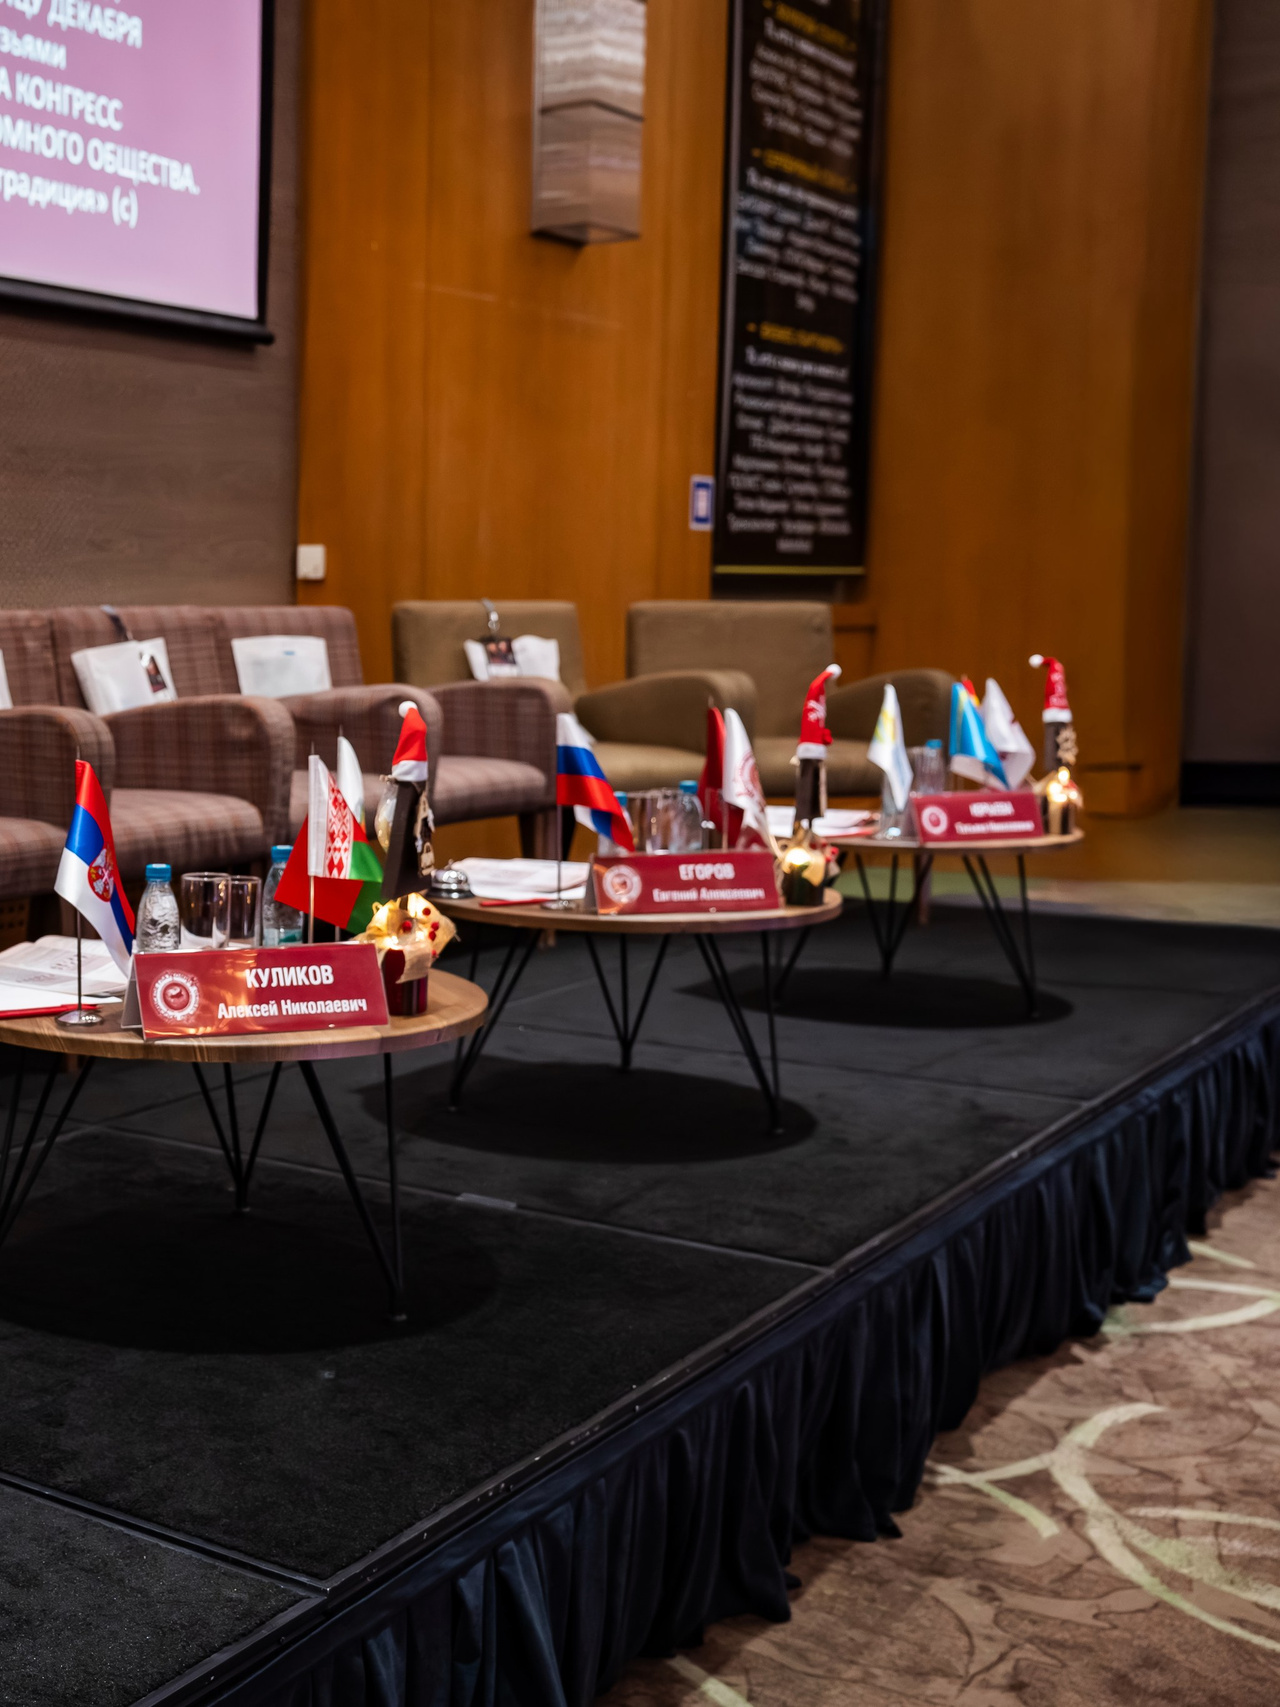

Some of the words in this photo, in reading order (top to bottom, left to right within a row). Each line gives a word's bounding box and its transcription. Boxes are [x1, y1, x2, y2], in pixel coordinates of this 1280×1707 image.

[47, 0, 143, 49] ДЕКАБРЯ
[16, 71, 123, 131] КОНГРЕСС
[87, 138, 200, 195] ОБЩЕСТВА.
[679, 863, 735, 881] ЕГОРОВ
[245, 965, 334, 988] КУЛИКОВ
[218, 1000, 278, 1019] Алексей
[281, 998, 368, 1016] Николаевич
